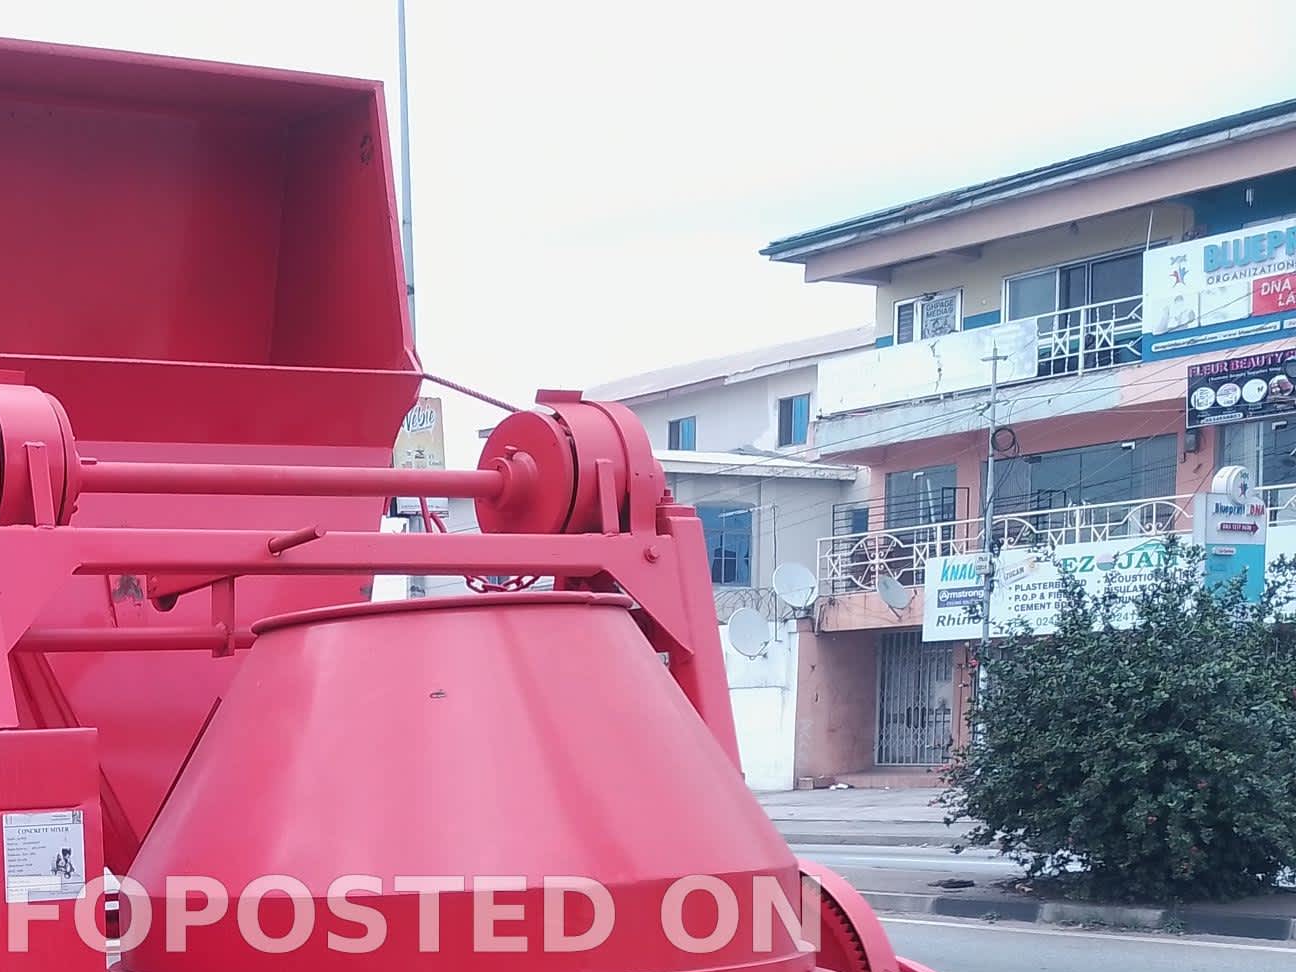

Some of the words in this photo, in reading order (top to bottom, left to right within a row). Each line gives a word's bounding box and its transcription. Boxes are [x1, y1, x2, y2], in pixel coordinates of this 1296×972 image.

[1207, 260, 1296, 285] ORGANIZATION
[1261, 278, 1291, 297] DNA
[1231, 353, 1284, 370] BEAUTY
[1250, 504, 1265, 516] DNA
[1058, 555, 1095, 574] EZ
[1118, 551, 1179, 569] JAM
[1015, 579, 1087, 592] PLASTERBORD
[939, 590, 984, 602] Armstrong
[1014, 602, 1051, 612] CEMENT
[936, 614, 983, 626] Rhino
